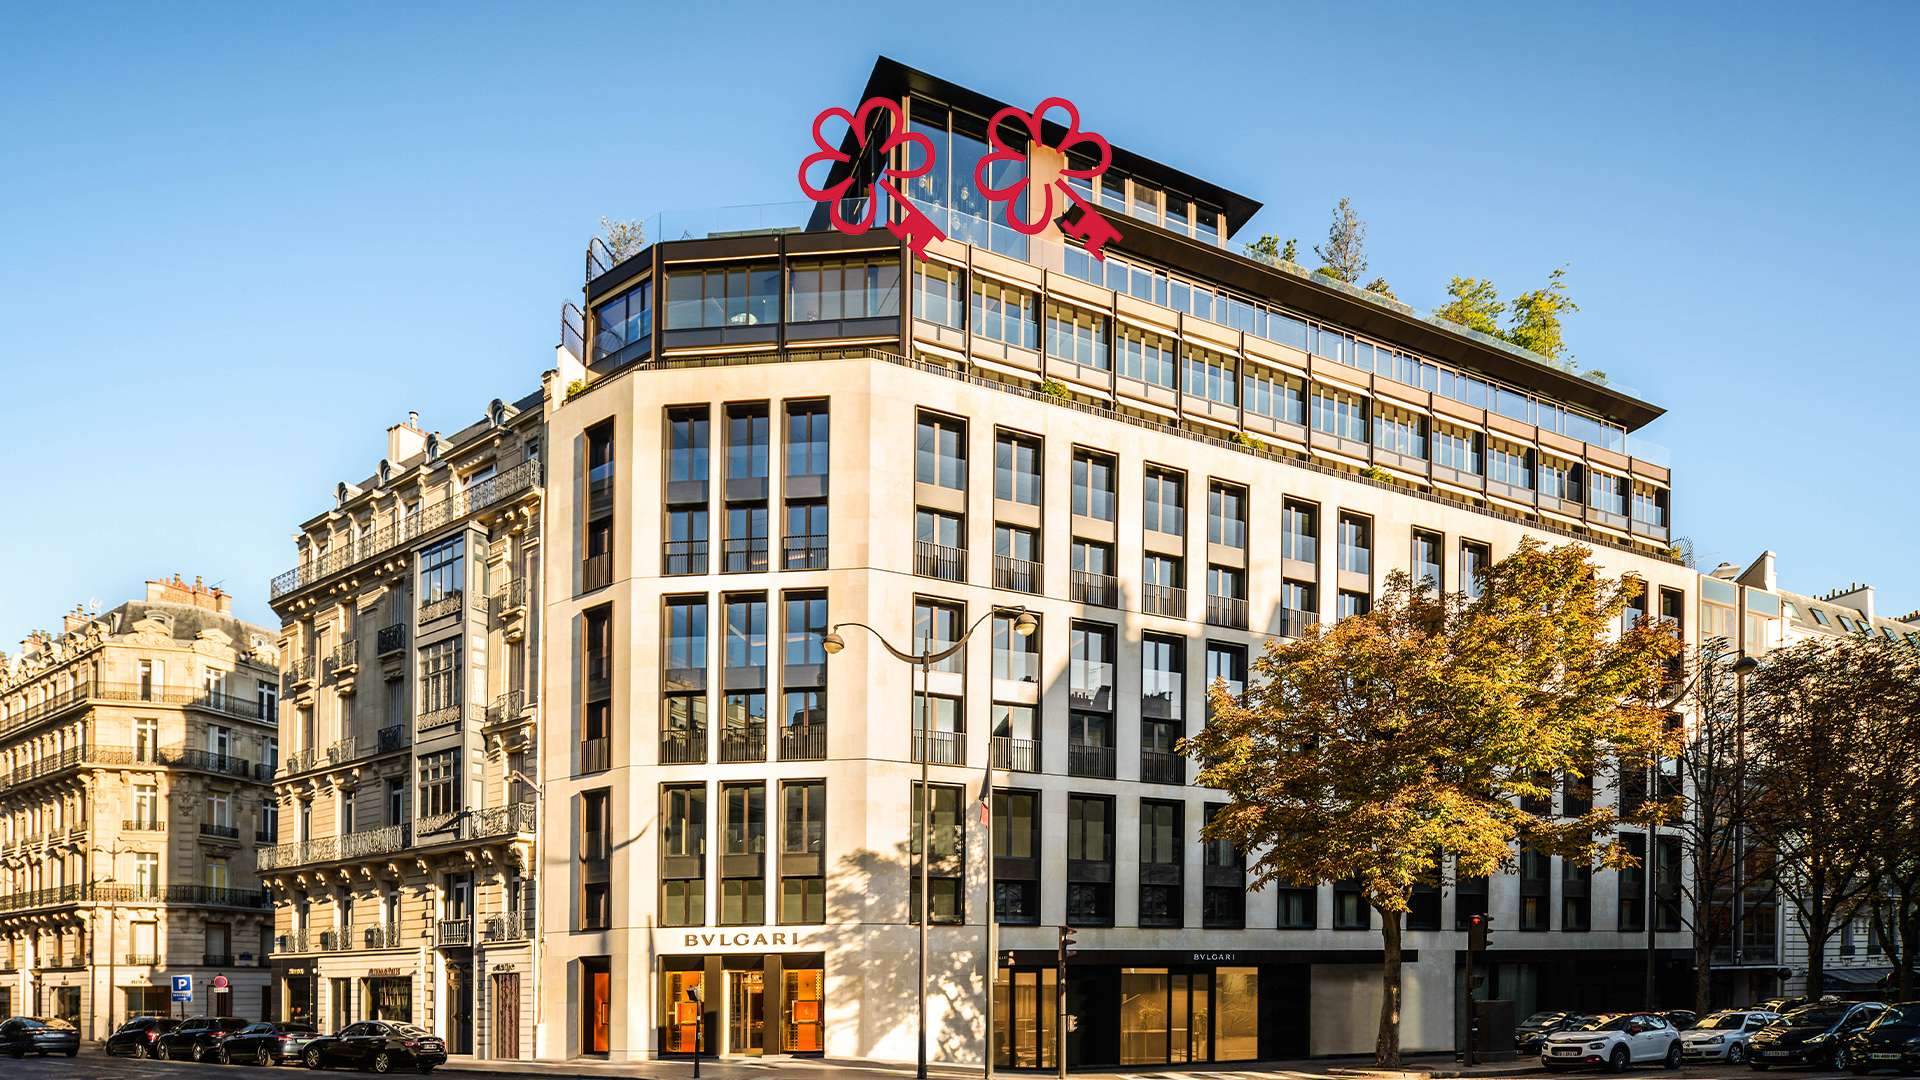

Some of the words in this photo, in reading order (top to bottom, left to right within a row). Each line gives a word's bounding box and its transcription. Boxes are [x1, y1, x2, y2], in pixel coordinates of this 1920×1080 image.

[684, 932, 798, 947] BVLGARI
[1193, 953, 1235, 961] BVLGARI
[178, 979, 188, 990] P
